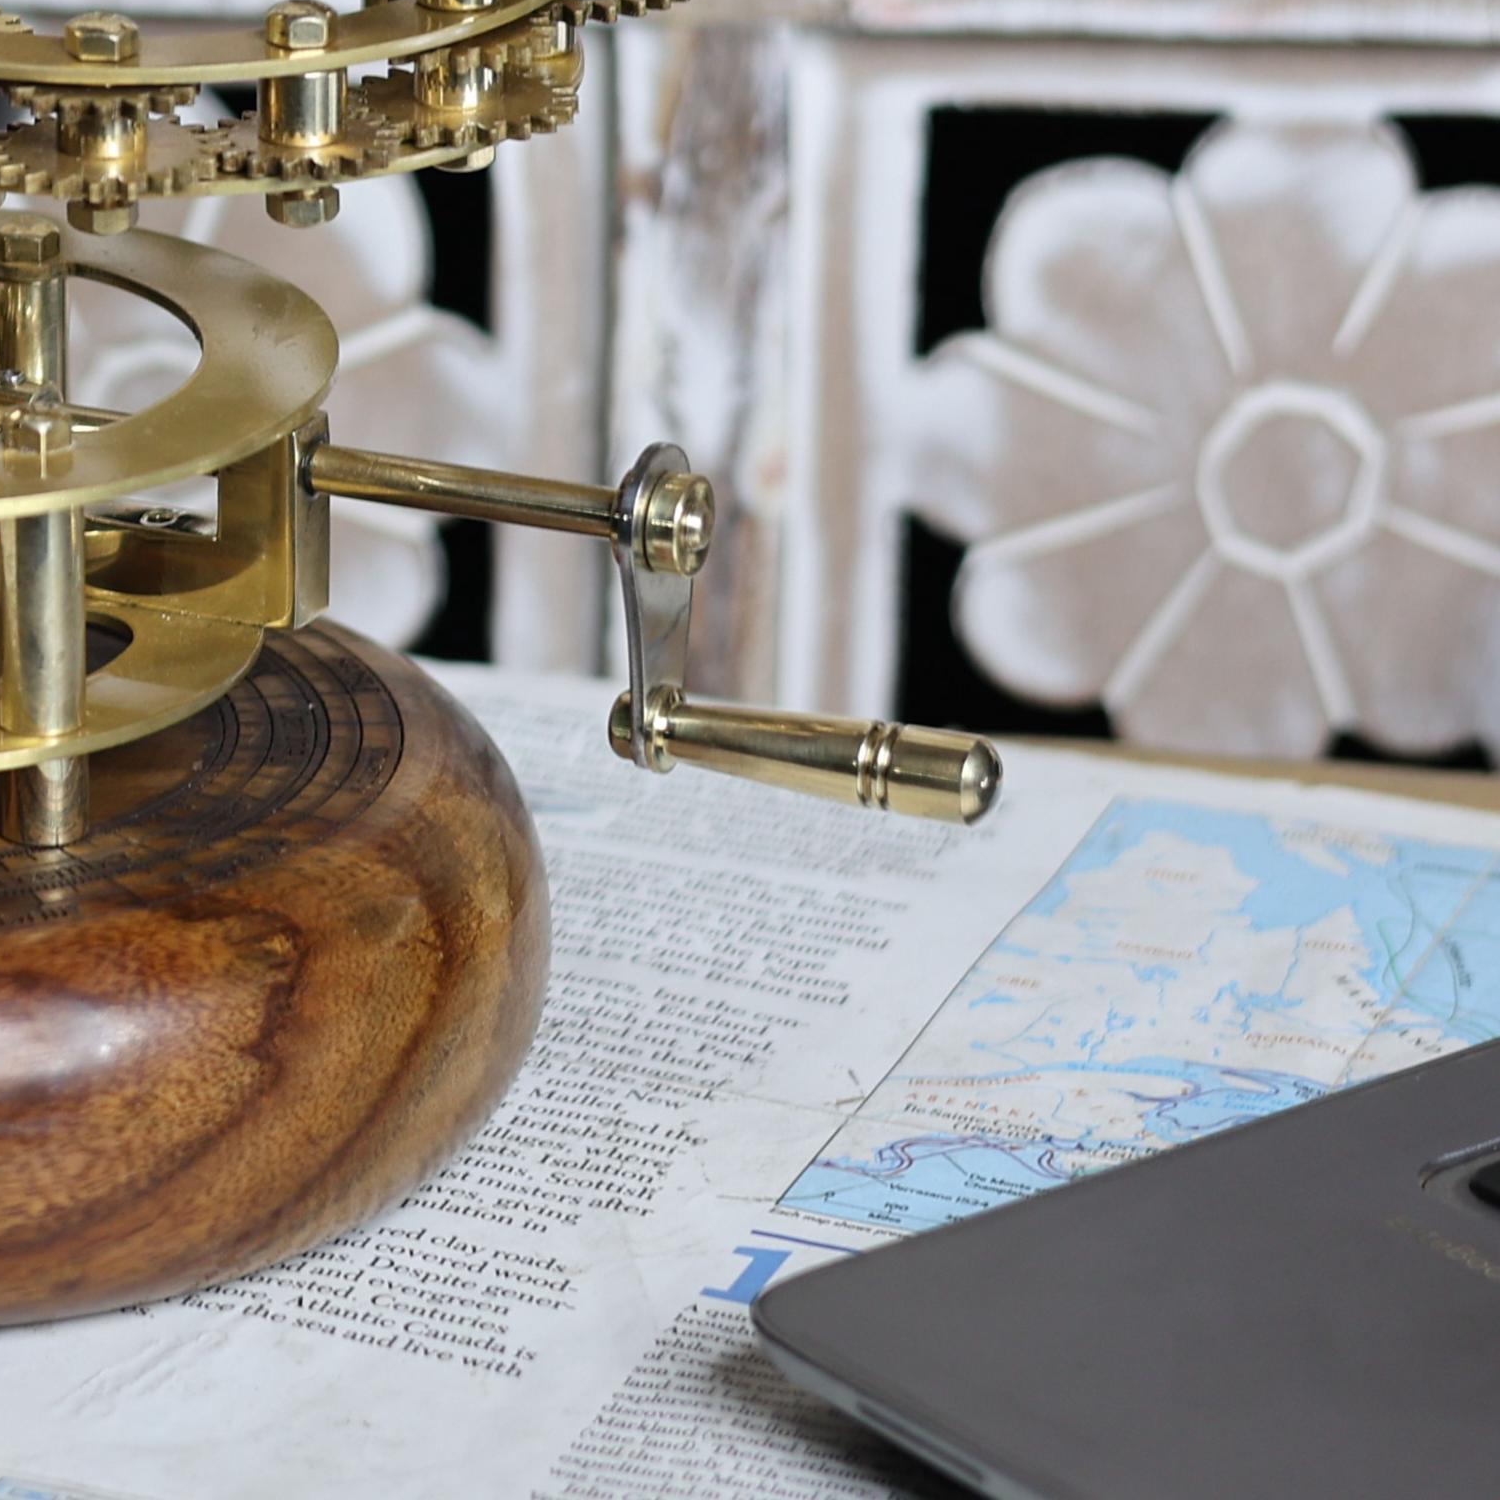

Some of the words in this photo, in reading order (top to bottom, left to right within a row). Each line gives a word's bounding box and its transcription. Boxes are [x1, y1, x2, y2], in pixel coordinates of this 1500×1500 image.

[657, 1002, 771, 1037] England
[651, 1049, 717, 1072] their
[546, 1076, 618, 1097] notes
[625, 1088, 689, 1112] New
[509, 1113, 601, 1140] British
[664, 1127, 709, 1149] the
[539, 1152, 655, 1185] Isolation
[546, 1170, 658, 1202] Scottish
[478, 1175, 584, 1208] masters
[587, 1197, 656, 1219] after
[492, 1196, 583, 1227] giving
[521, 1215, 549, 1234] in
[373, 1241, 489, 1275] covered
[494, 1266, 580, 1294] wood-
[377, 1225, 428, 1242] red
[429, 1235, 486, 1258] clay
[491, 1249, 568, 1275] roads
[309, 1267, 365, 1283] and
[367, 1276, 511, 1317] evergreen
[368, 1255, 478, 1291] Despite
[480, 1283, 578, 1312] gener-
[700, 1246, 794, 1306] 1
[285, 1295, 398, 1330] Atlantic
[402, 1319, 508, 1356] Canada
[514, 1345, 539, 1363] is
[370, 1293, 511, 1336] Centuries
[242, 1303, 288, 1324] the
[292, 1317, 338, 1337] sea
[342, 1333, 400, 1350] and
[402, 1337, 455, 1363] live
[461, 1354, 524, 1380] with
